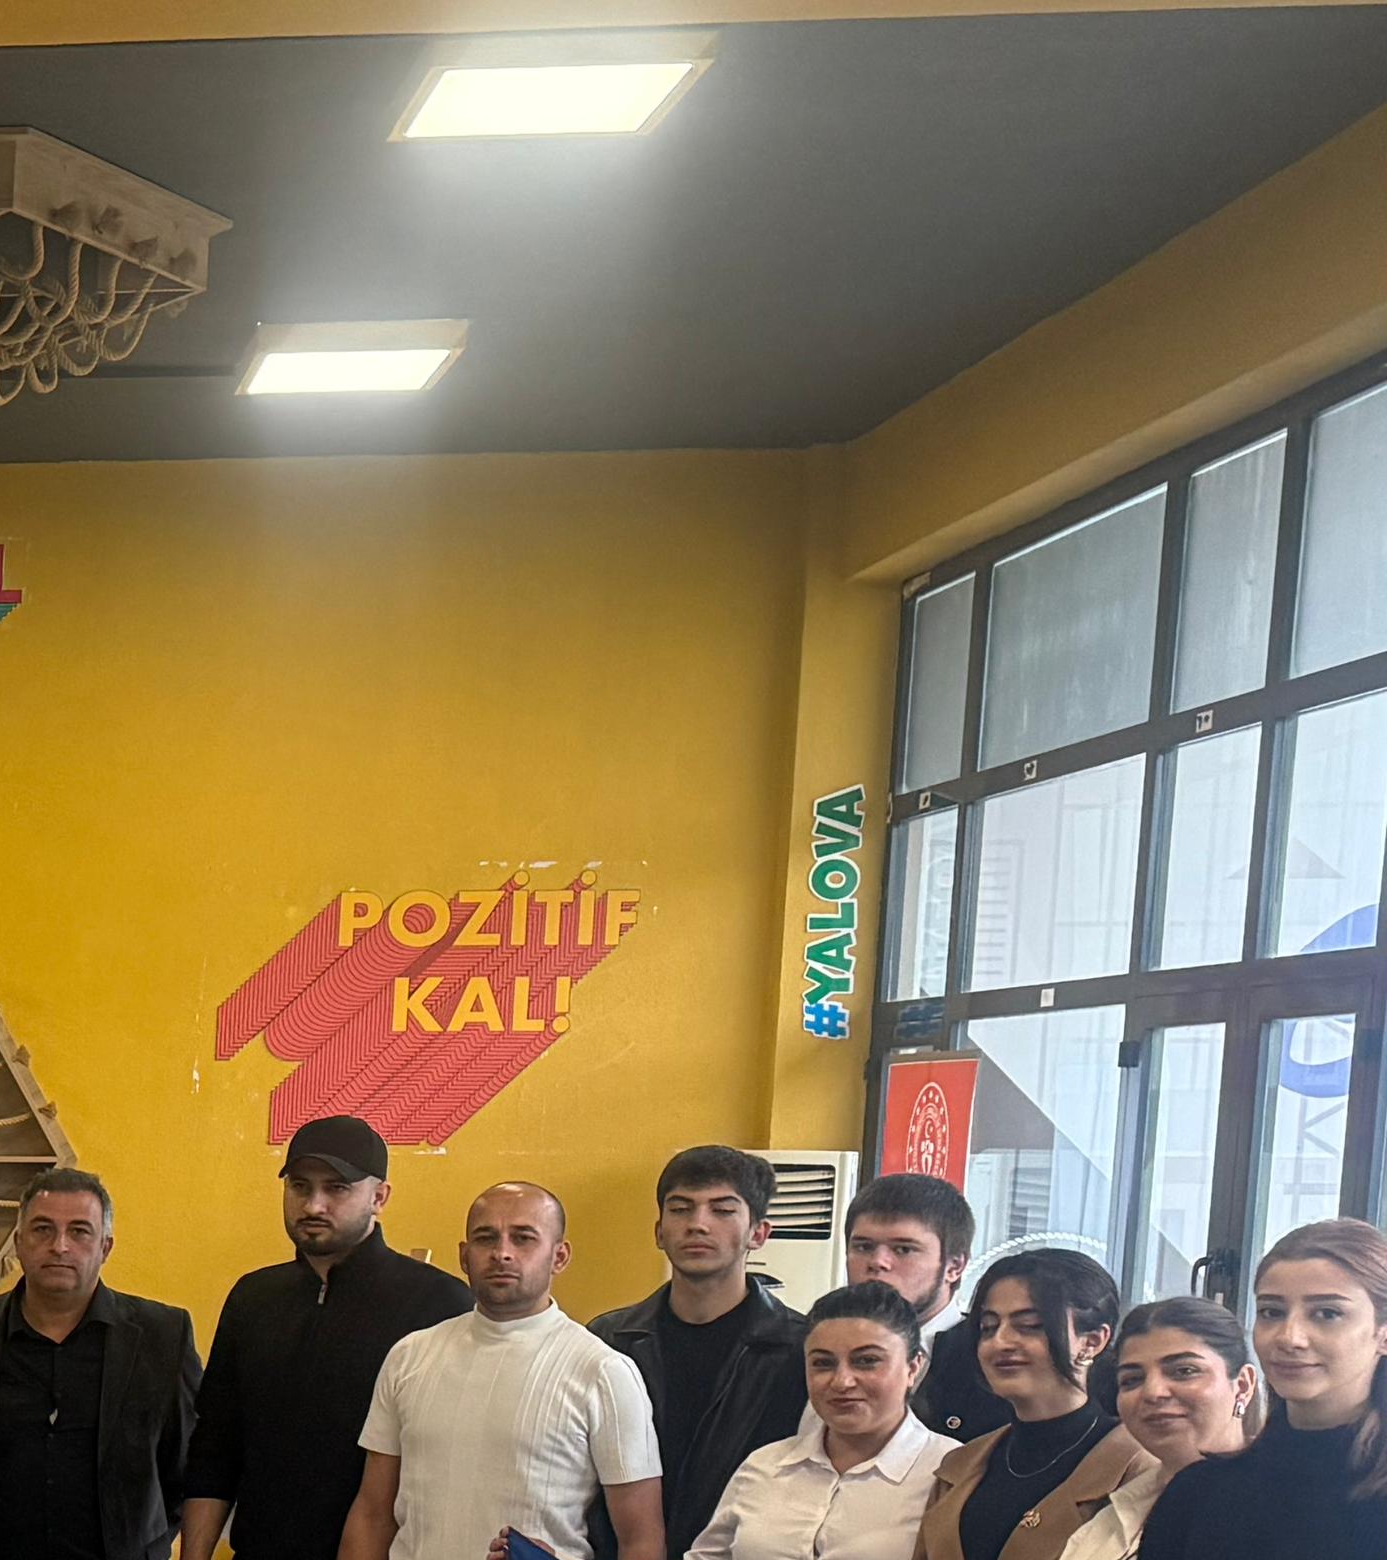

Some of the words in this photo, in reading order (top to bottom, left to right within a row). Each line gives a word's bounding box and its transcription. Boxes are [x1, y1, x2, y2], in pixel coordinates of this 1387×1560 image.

[337, 869, 641, 948] POZİTİF
[802, 783, 867, 1040] #YALOVA
[391, 975, 572, 1034] KAL!
